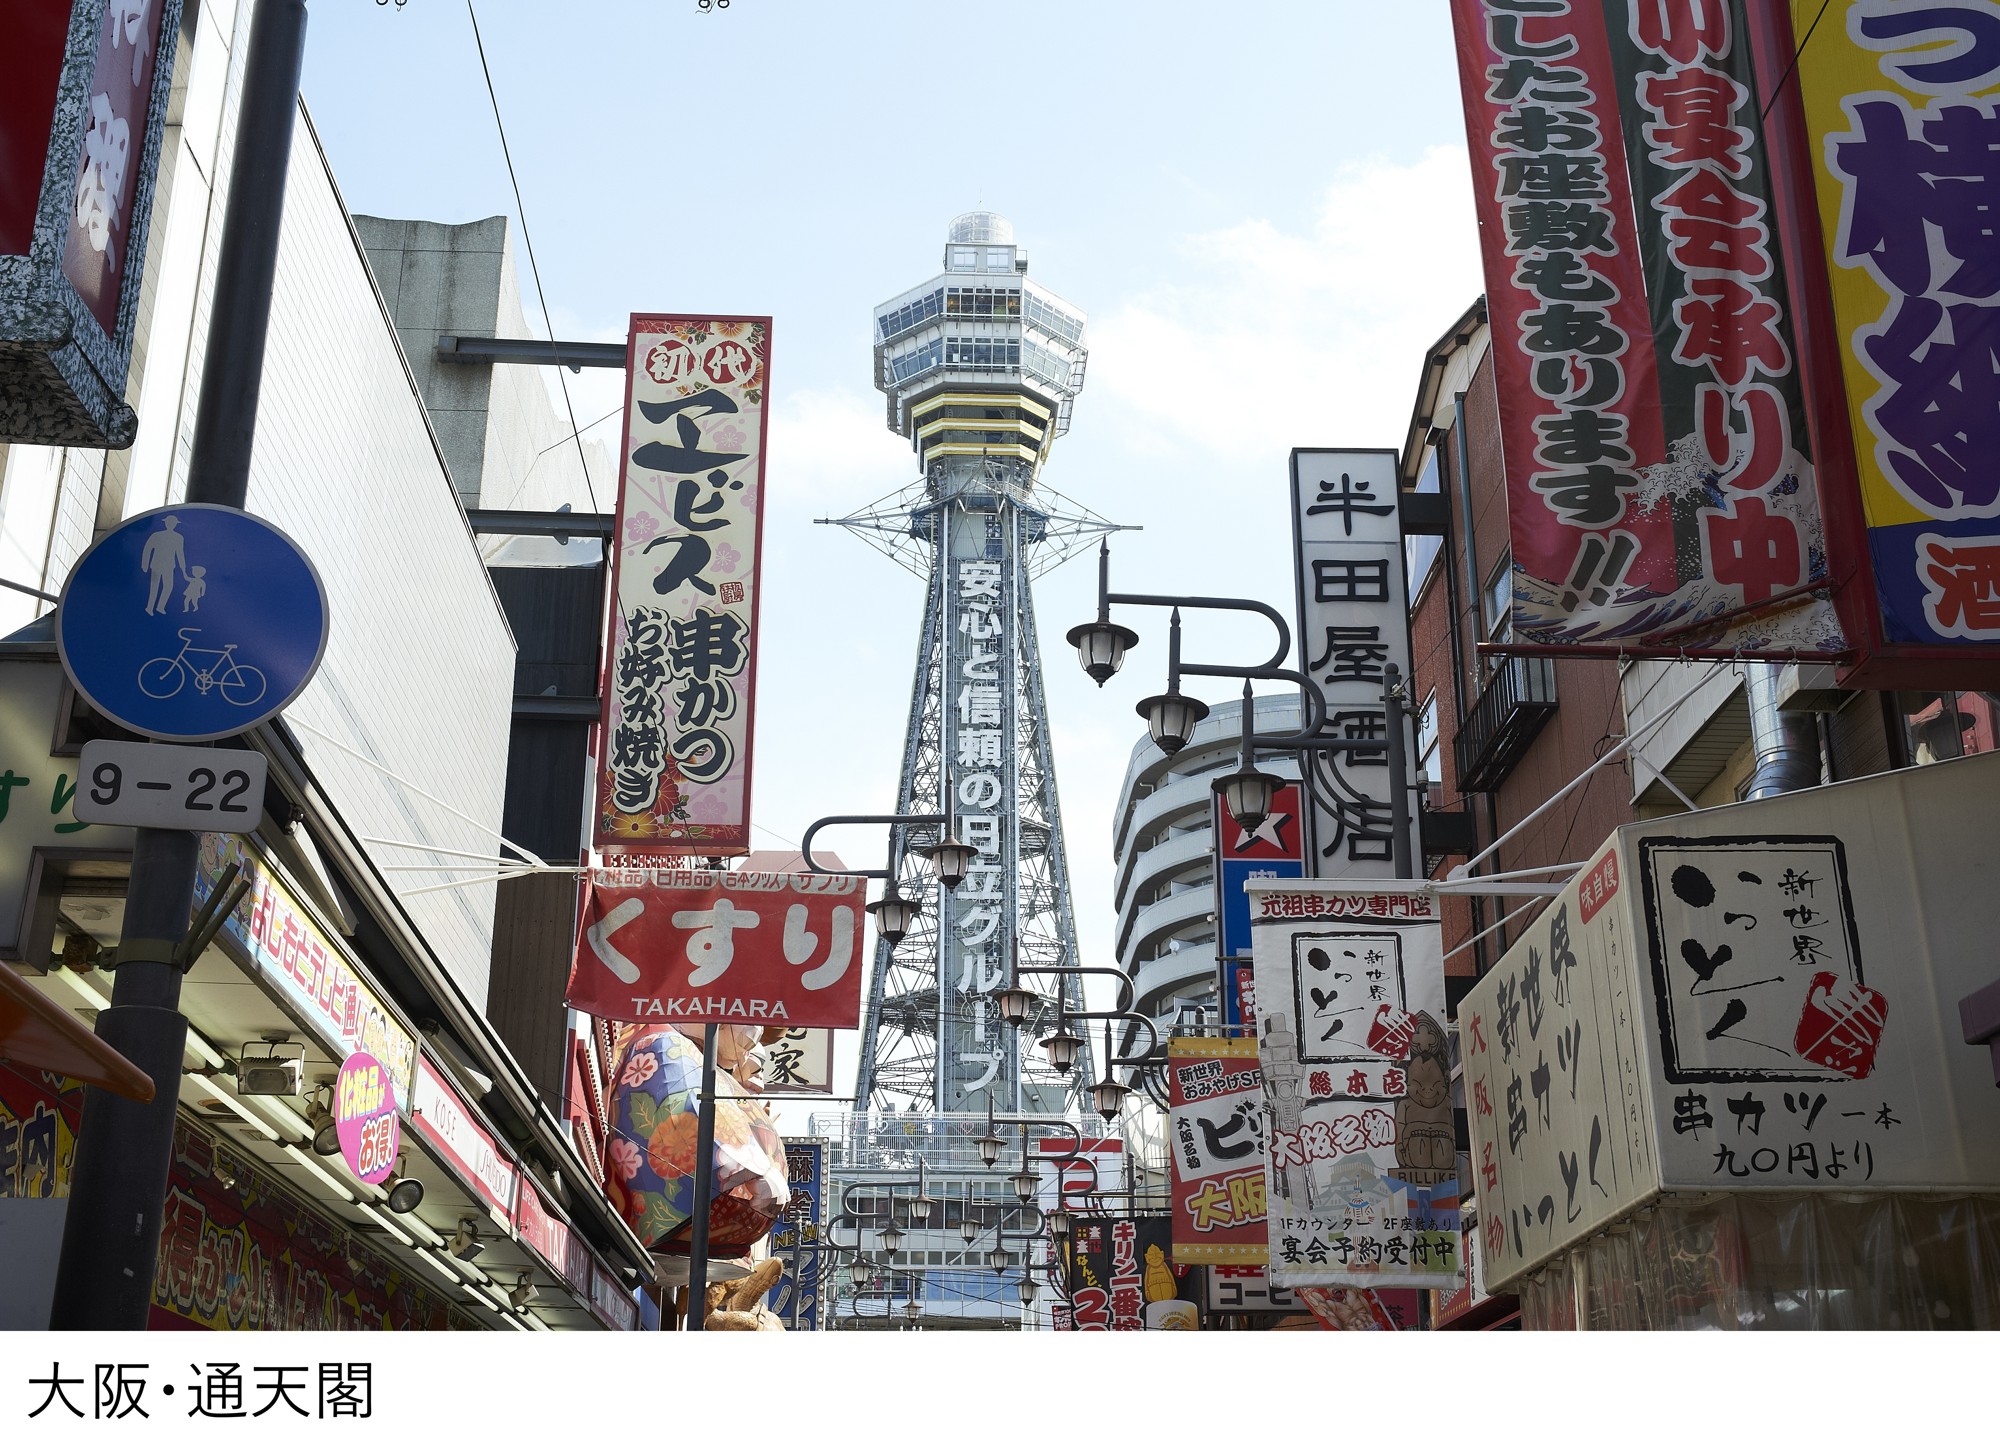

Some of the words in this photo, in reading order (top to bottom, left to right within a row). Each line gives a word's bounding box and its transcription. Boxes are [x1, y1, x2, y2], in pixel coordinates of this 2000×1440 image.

[647, 341, 753, 385] 初代
[631, 388, 751, 597] エビス
[669, 607, 750, 785] 串かつ
[1306, 472, 1412, 862] 半田屋酒店
[611, 605, 669, 815] お好み焼き
[957, 559, 1004, 1092] 安心と信頼の日立グループ
[1261, 894, 1432, 917] 元祖串カツ専門店
[1777, 867, 1833, 966] 新世界
[586, 897, 855, 991] くすり
[1363, 949, 1392, 1003] 新世界
[1496, 901, 1578, 1066] 新世界
[630, 996, 790, 1019] TAKAHARA
[1177, 1060, 1224, 1084] 新世界
[1309, 1068, 1407, 1097] 総本店
[1506, 1018, 1582, 1162] 串カツ
[1176, 1116, 1201, 1171] 大阪名物
[1270, 1107, 1399, 1168] 大阪名物
[1469, 1010, 1507, 1260] 大阪名物
[1189, 1172, 1268, 1229] 大阪
[1278, 1234, 1456, 1266] 宴会予約受付中
[1219, 1282, 1300, 1306] コーヒ
